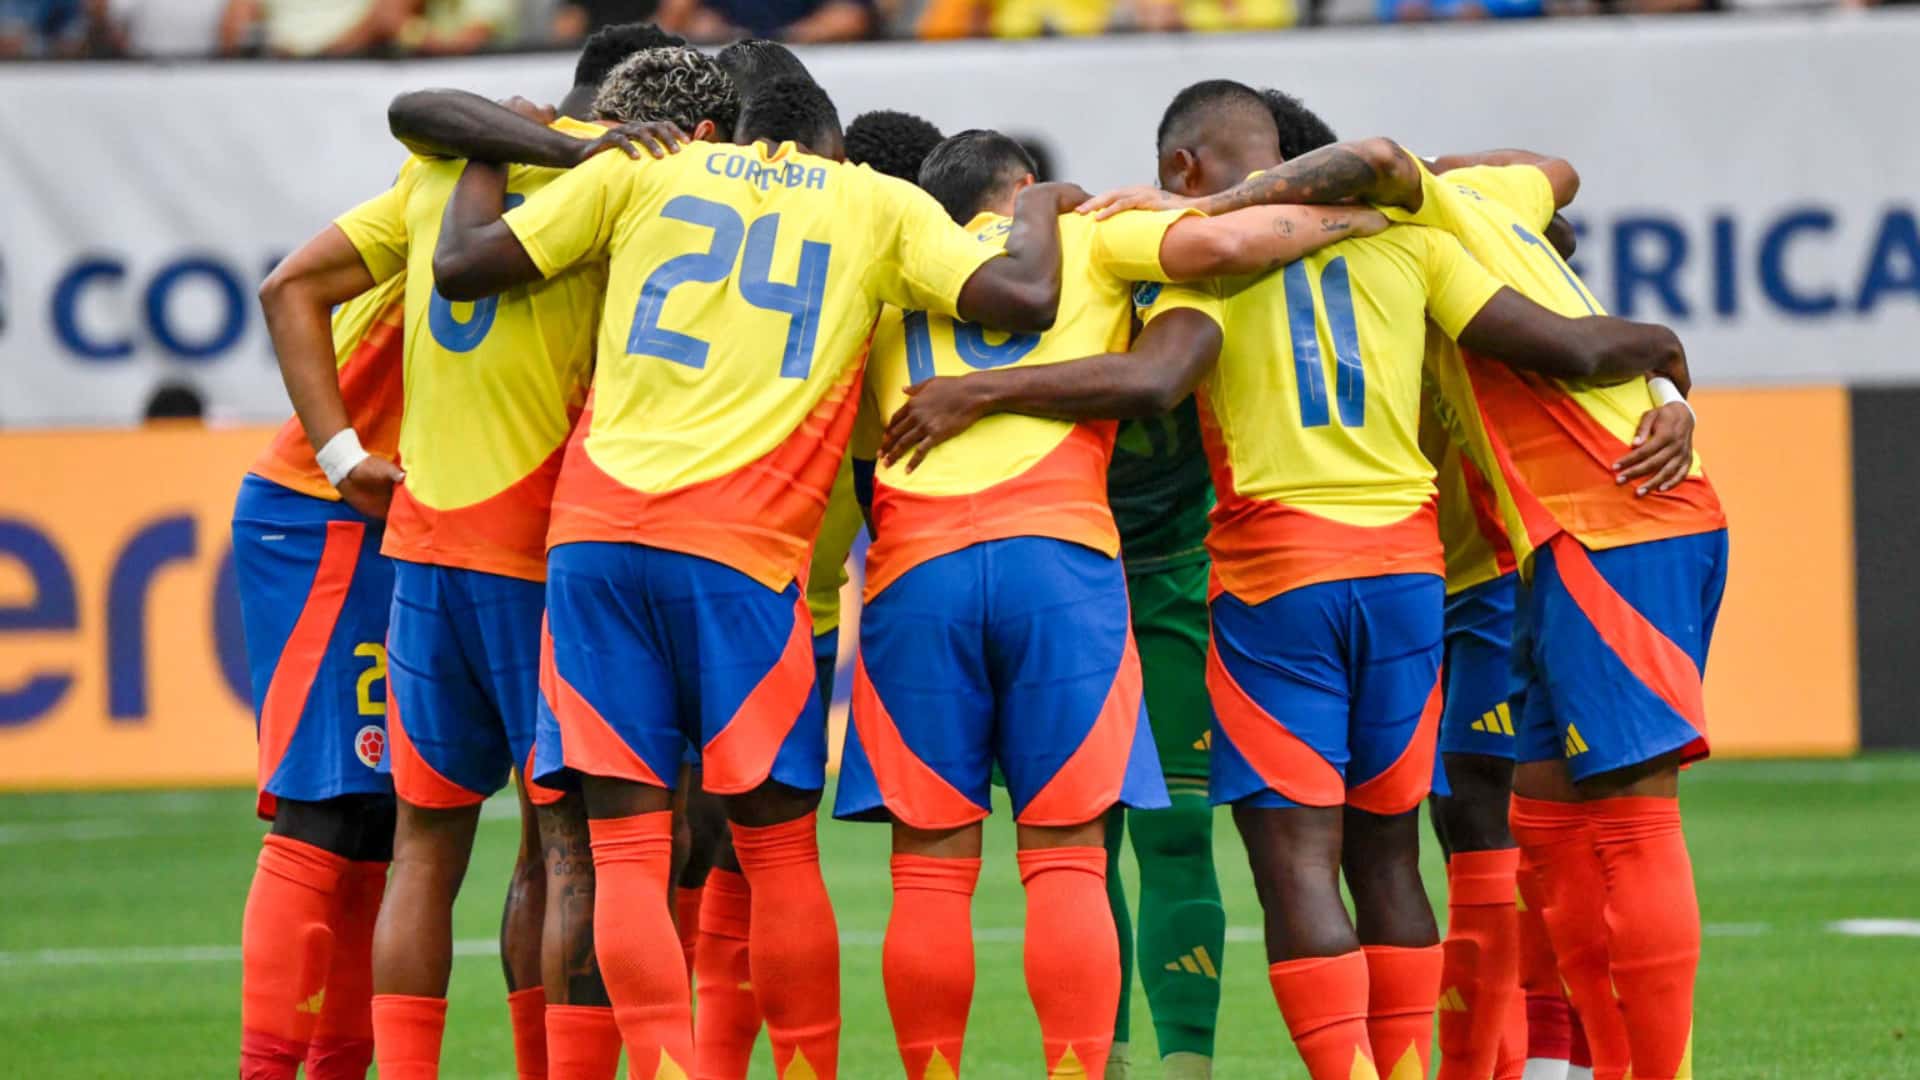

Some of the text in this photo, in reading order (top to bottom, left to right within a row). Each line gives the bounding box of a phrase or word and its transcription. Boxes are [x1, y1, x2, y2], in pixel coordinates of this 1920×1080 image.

[51, 254, 290, 362] CO
[626, 194, 832, 381] 24
[1567, 206, 1920, 324] RICA
[1284, 254, 1365, 427] 11
